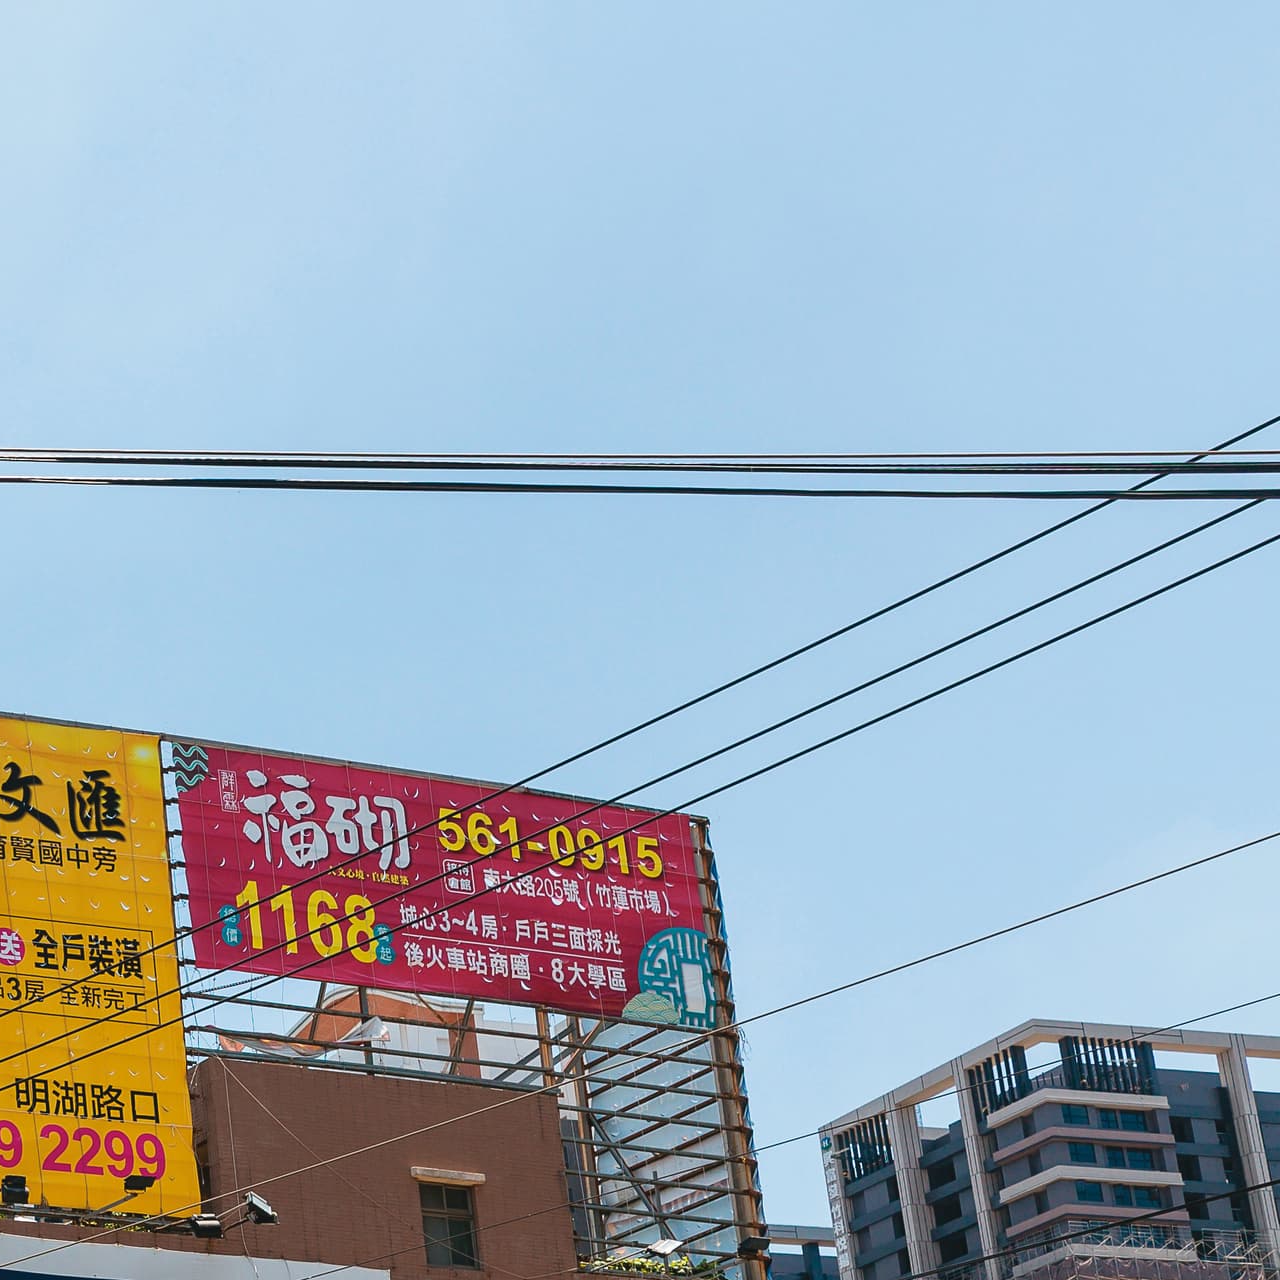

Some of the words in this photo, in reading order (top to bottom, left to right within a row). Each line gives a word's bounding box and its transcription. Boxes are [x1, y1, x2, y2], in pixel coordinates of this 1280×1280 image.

[438, 806, 664, 879] 561-0915
[236, 880, 379, 964] 1168
[33, 928, 144, 980] 全戶裝潢
[60, 984, 146, 1013] 全新完工
[15, 1076, 160, 1124] 明湖路口
[42, 1124, 166, 1180] 2299
